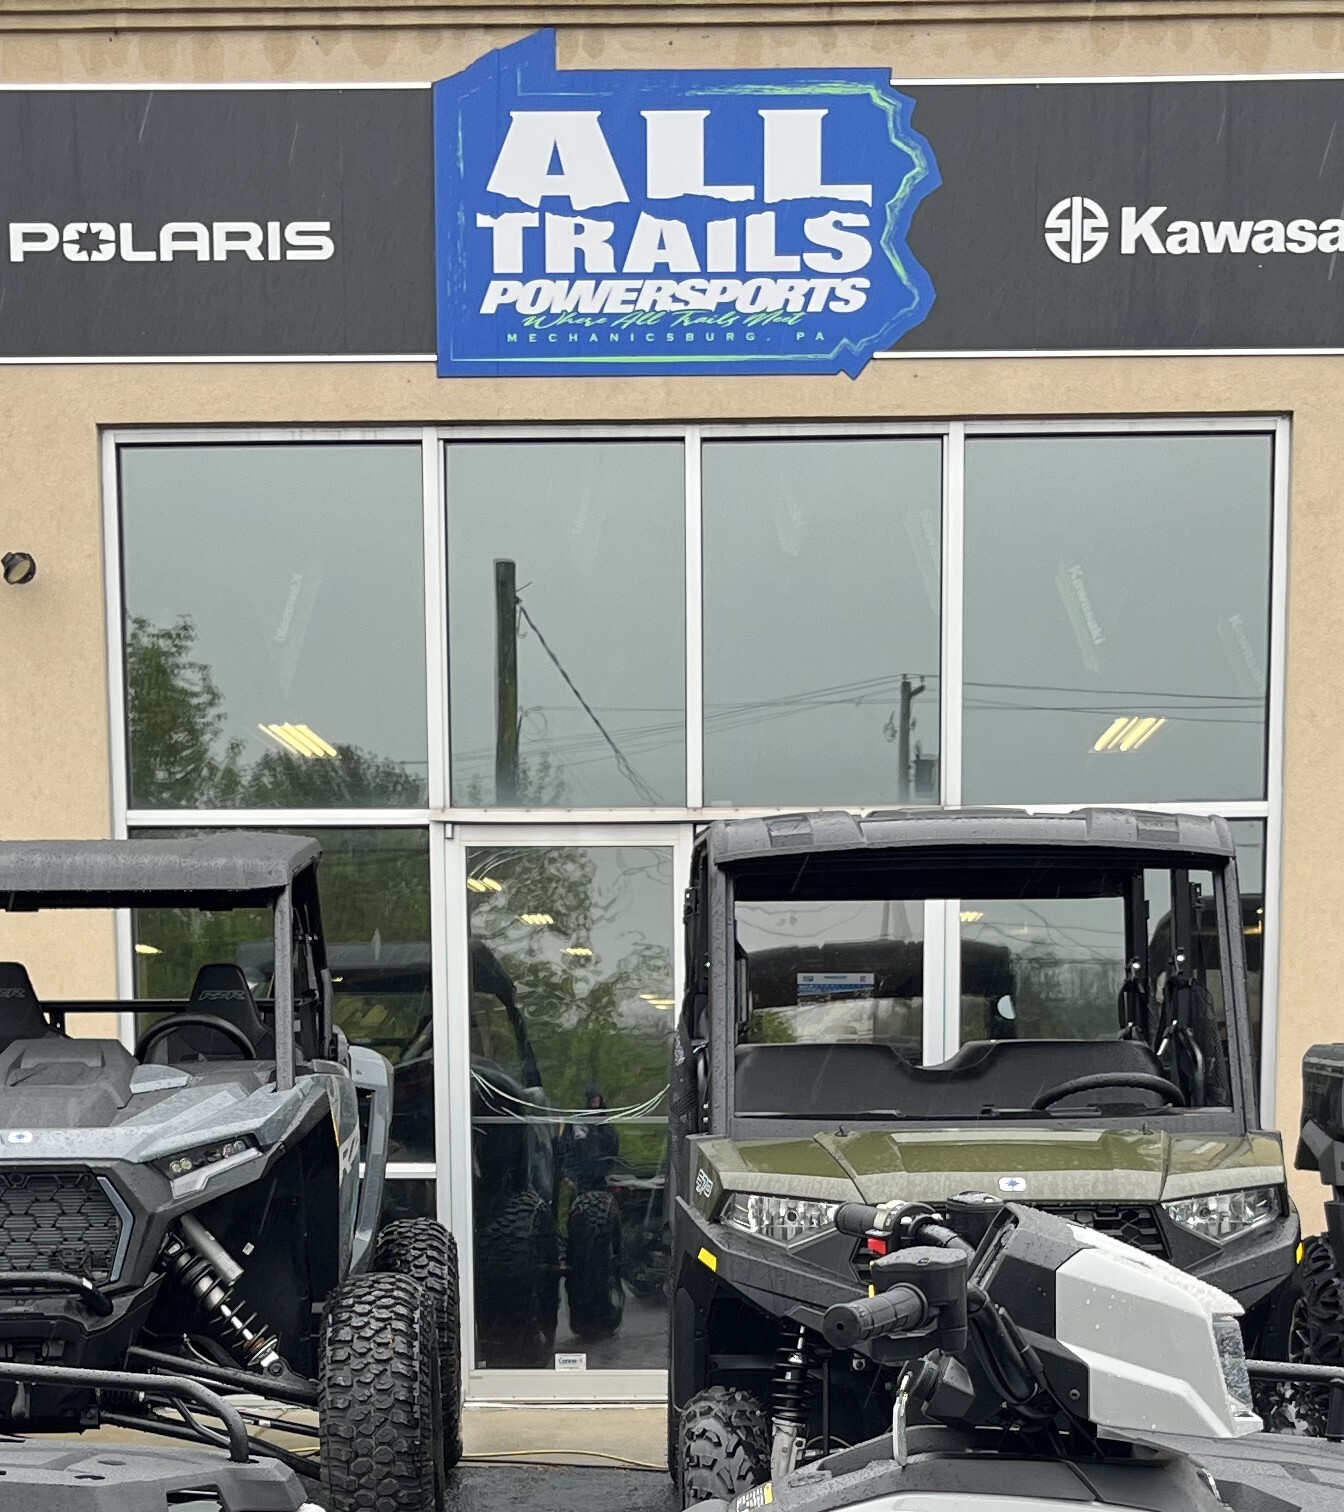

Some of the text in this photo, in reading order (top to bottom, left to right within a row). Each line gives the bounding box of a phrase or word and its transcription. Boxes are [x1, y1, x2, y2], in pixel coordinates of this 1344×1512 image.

[486, 109, 873, 210] ALL
[9, 221, 335, 263] POLARIS
[476, 210, 873, 275] TRAILS
[479, 278, 872, 315] POWERSPORTS
[522, 308, 806, 330] Where All Trails Meet
[796, 331, 825, 343] PA
